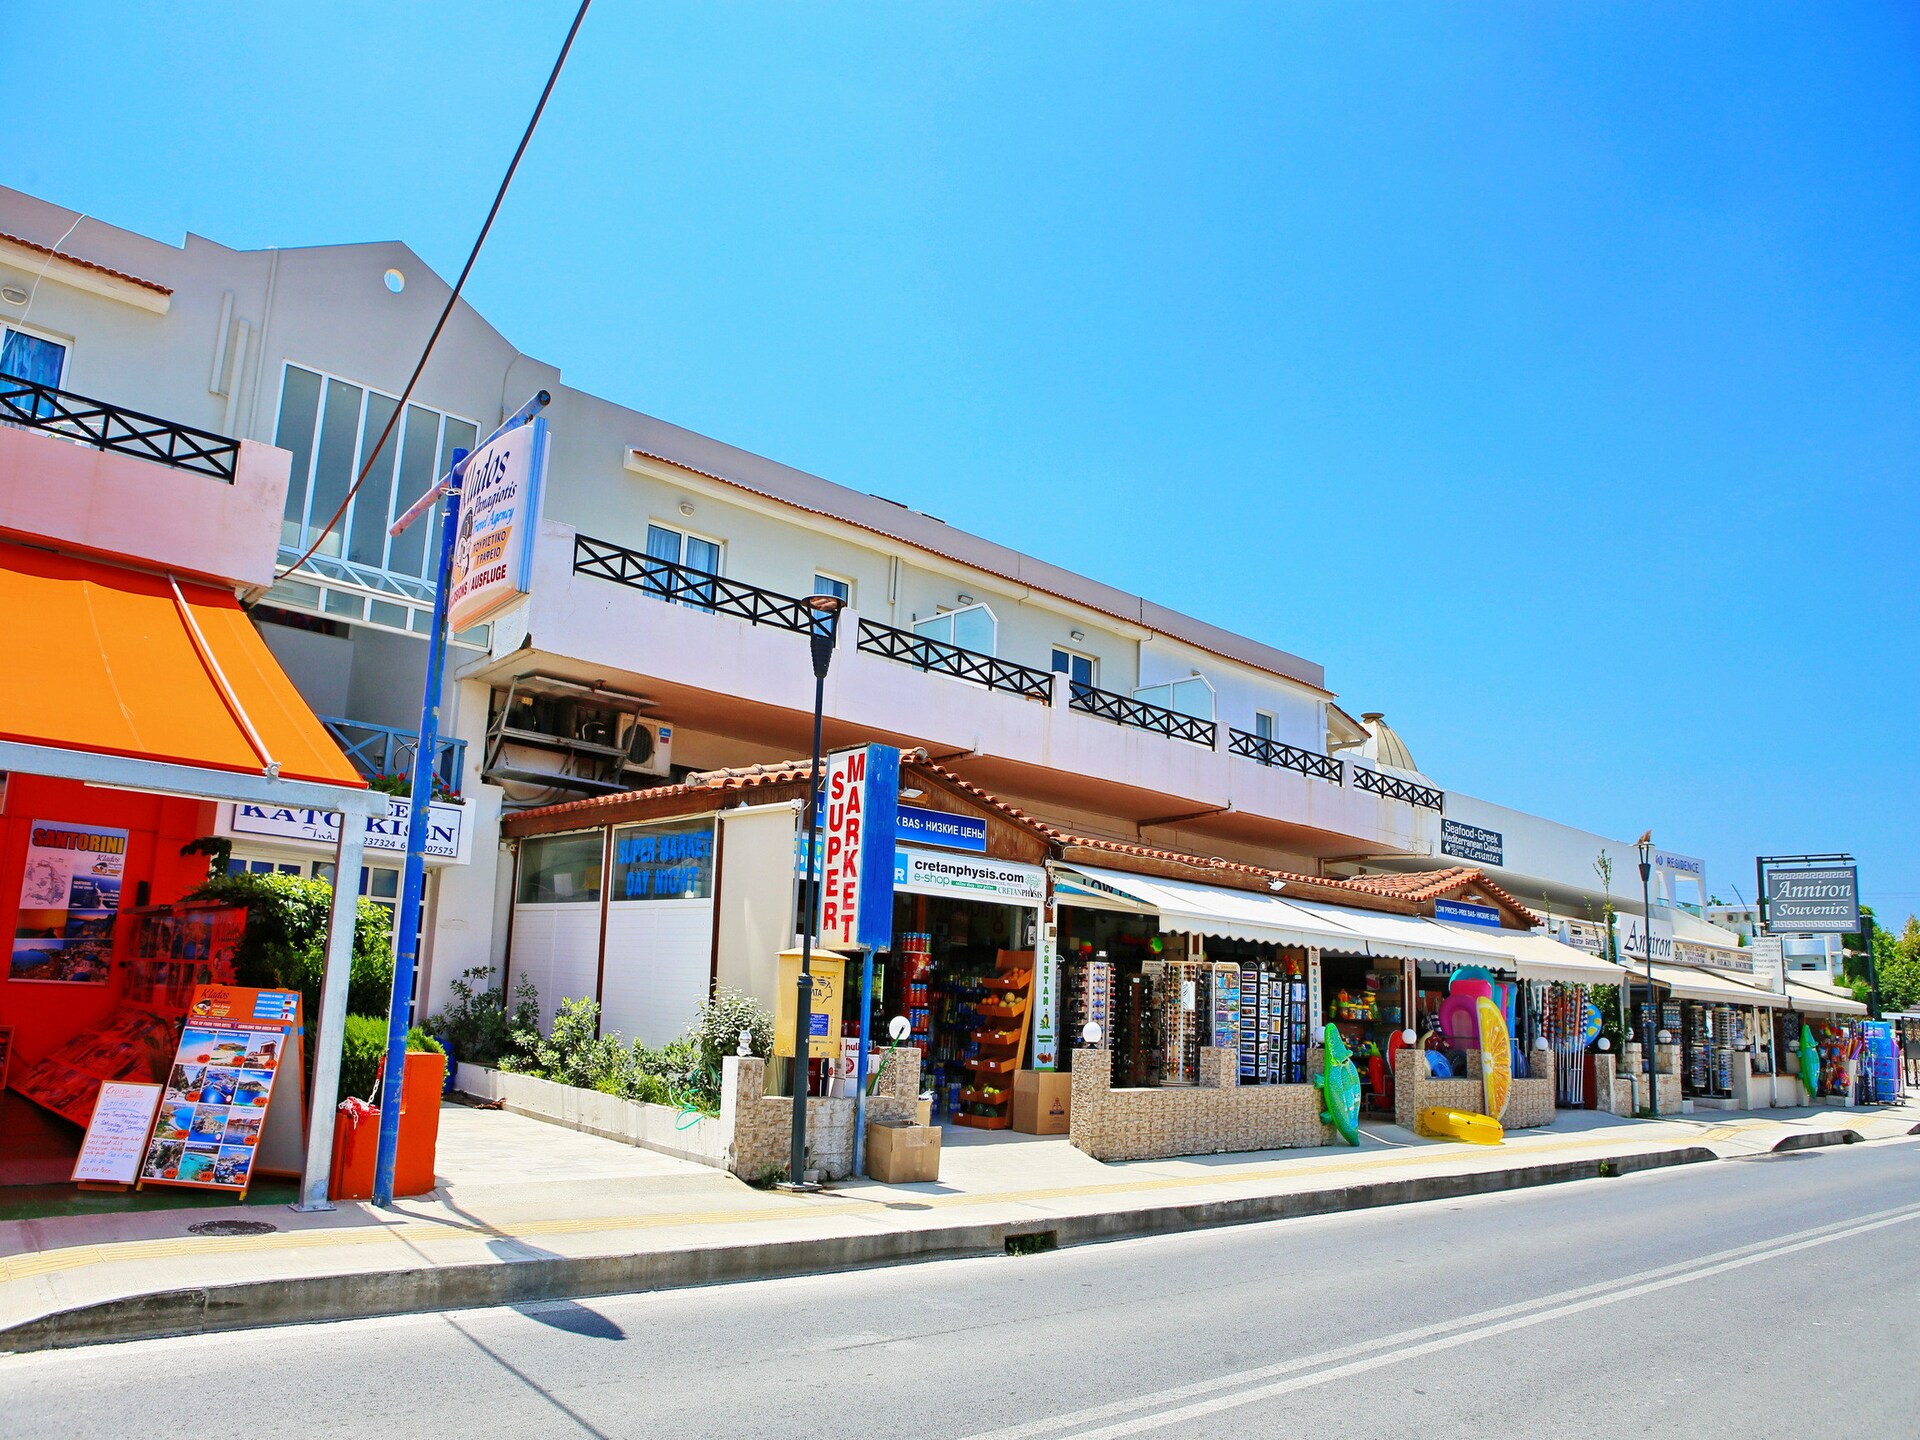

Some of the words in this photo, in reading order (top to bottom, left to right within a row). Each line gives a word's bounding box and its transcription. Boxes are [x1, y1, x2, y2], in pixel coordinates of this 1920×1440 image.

[926, 822, 959, 835] НИЗКИЕ
[961, 827, 985, 840] ЦЕНЫ
[32, 827, 125, 854] SANTORINI
[842, 753, 866, 943] MARKET
[823, 771, 845, 931] SUPER
[914, 860, 1024, 884] cretanphysis.com
[1667, 857, 1699, 873] RESIDENCE
[914, 871, 950, 887] e-shop
[998, 887, 1043, 899] CRETANPHYSIS
[1772, 880, 1852, 900] Anniron
[1776, 902, 1849, 917] Souvenirs
[201, 989, 230, 999] Klados
